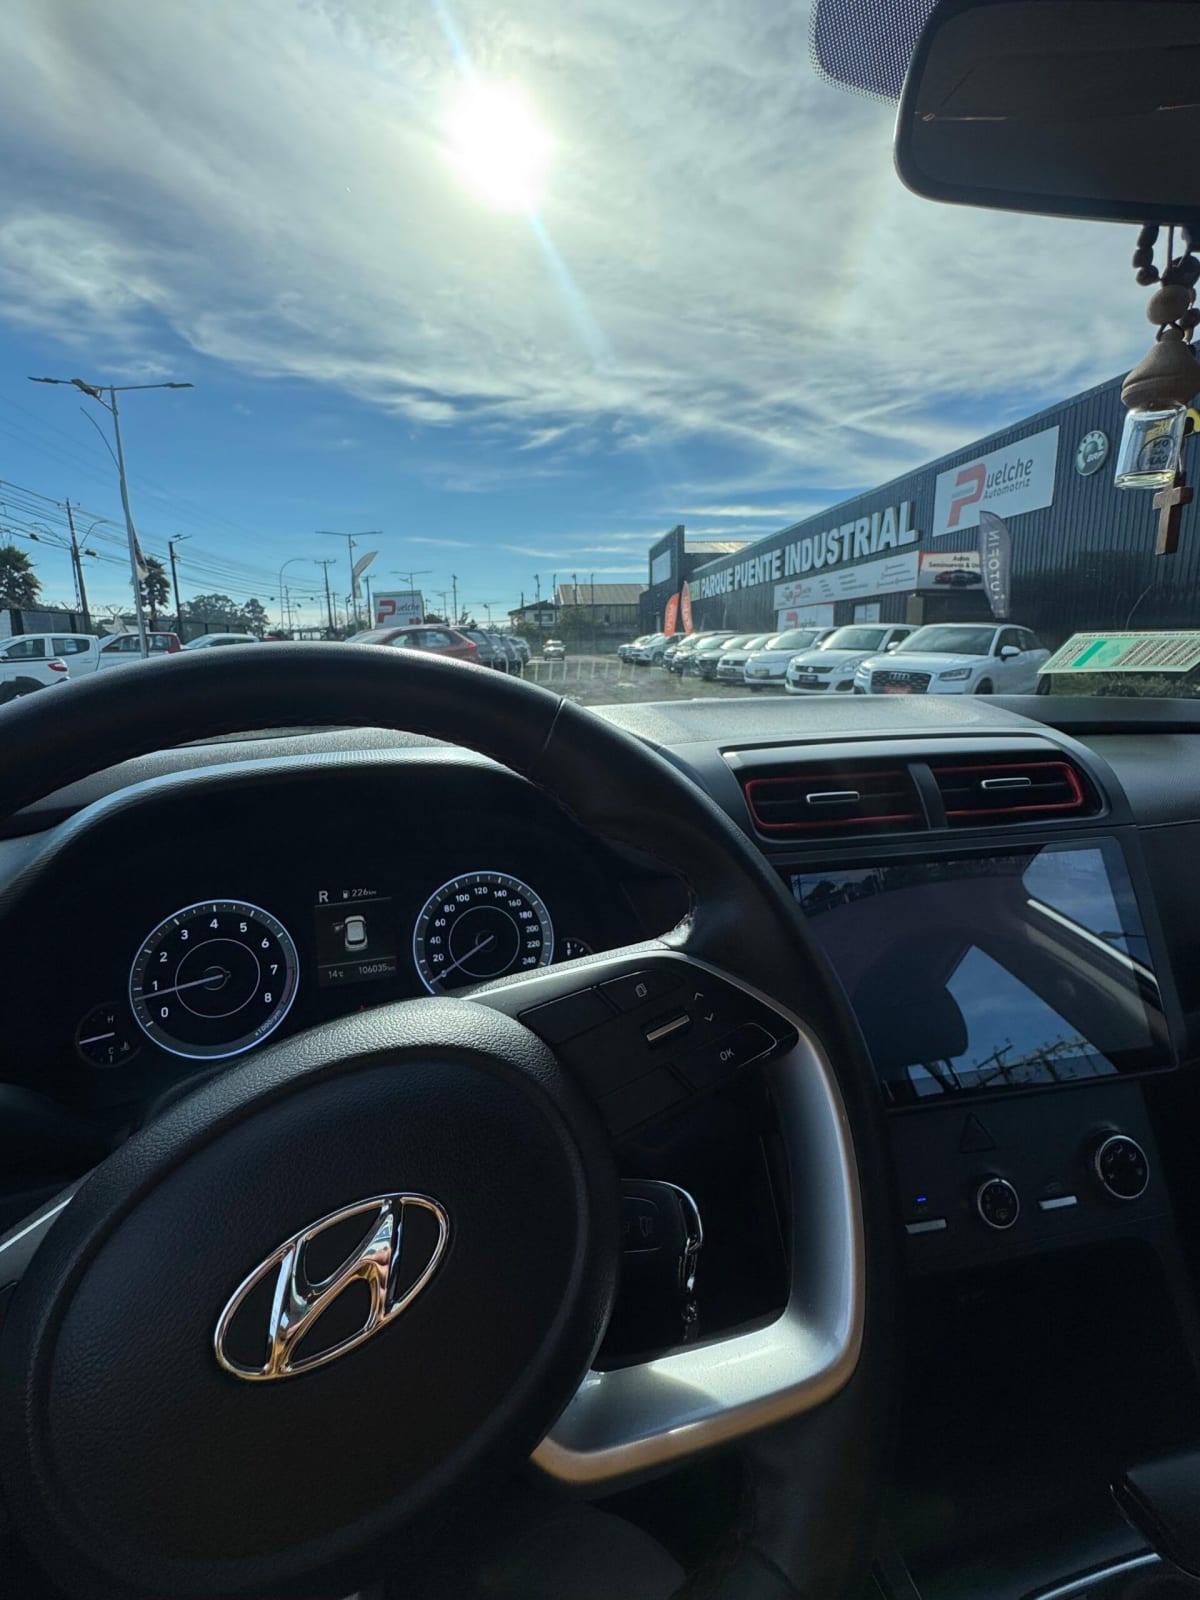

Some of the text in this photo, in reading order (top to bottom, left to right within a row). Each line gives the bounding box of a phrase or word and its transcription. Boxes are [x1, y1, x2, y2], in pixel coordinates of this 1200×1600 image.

[983, 478, 1031, 500] Automotriz
[700, 568, 734, 599] PARQUE
[734, 549, 783, 592] PUENTE
[784, 501, 920, 577] INDUSTRIAL
[474, 886, 488, 895] 120
[493, 889, 507, 898] 140
[318, 890, 329, 904] R
[455, 894, 470, 903] 100
[508, 898, 522, 907] 160
[444, 904, 455, 913] 80
[519, 910, 533, 919] 180
[209, 918, 219, 929] 4
[239, 922, 248, 933] 5
[434, 918, 446, 927] 60
[525, 924, 539, 933] 200
[180, 929, 189, 941] 3
[429, 936, 442, 945] 40
[261, 937, 270, 949] 6
[526, 940, 541, 949] 220
[159, 951, 168, 963] 2
[432, 953, 444, 962] 20
[270, 964, 279, 975] 7
[152, 980, 158, 991] 1
[263, 992, 273, 1004] 8
[160, 1007, 169, 1018] 0
[719, 1047, 736, 1062] OK
